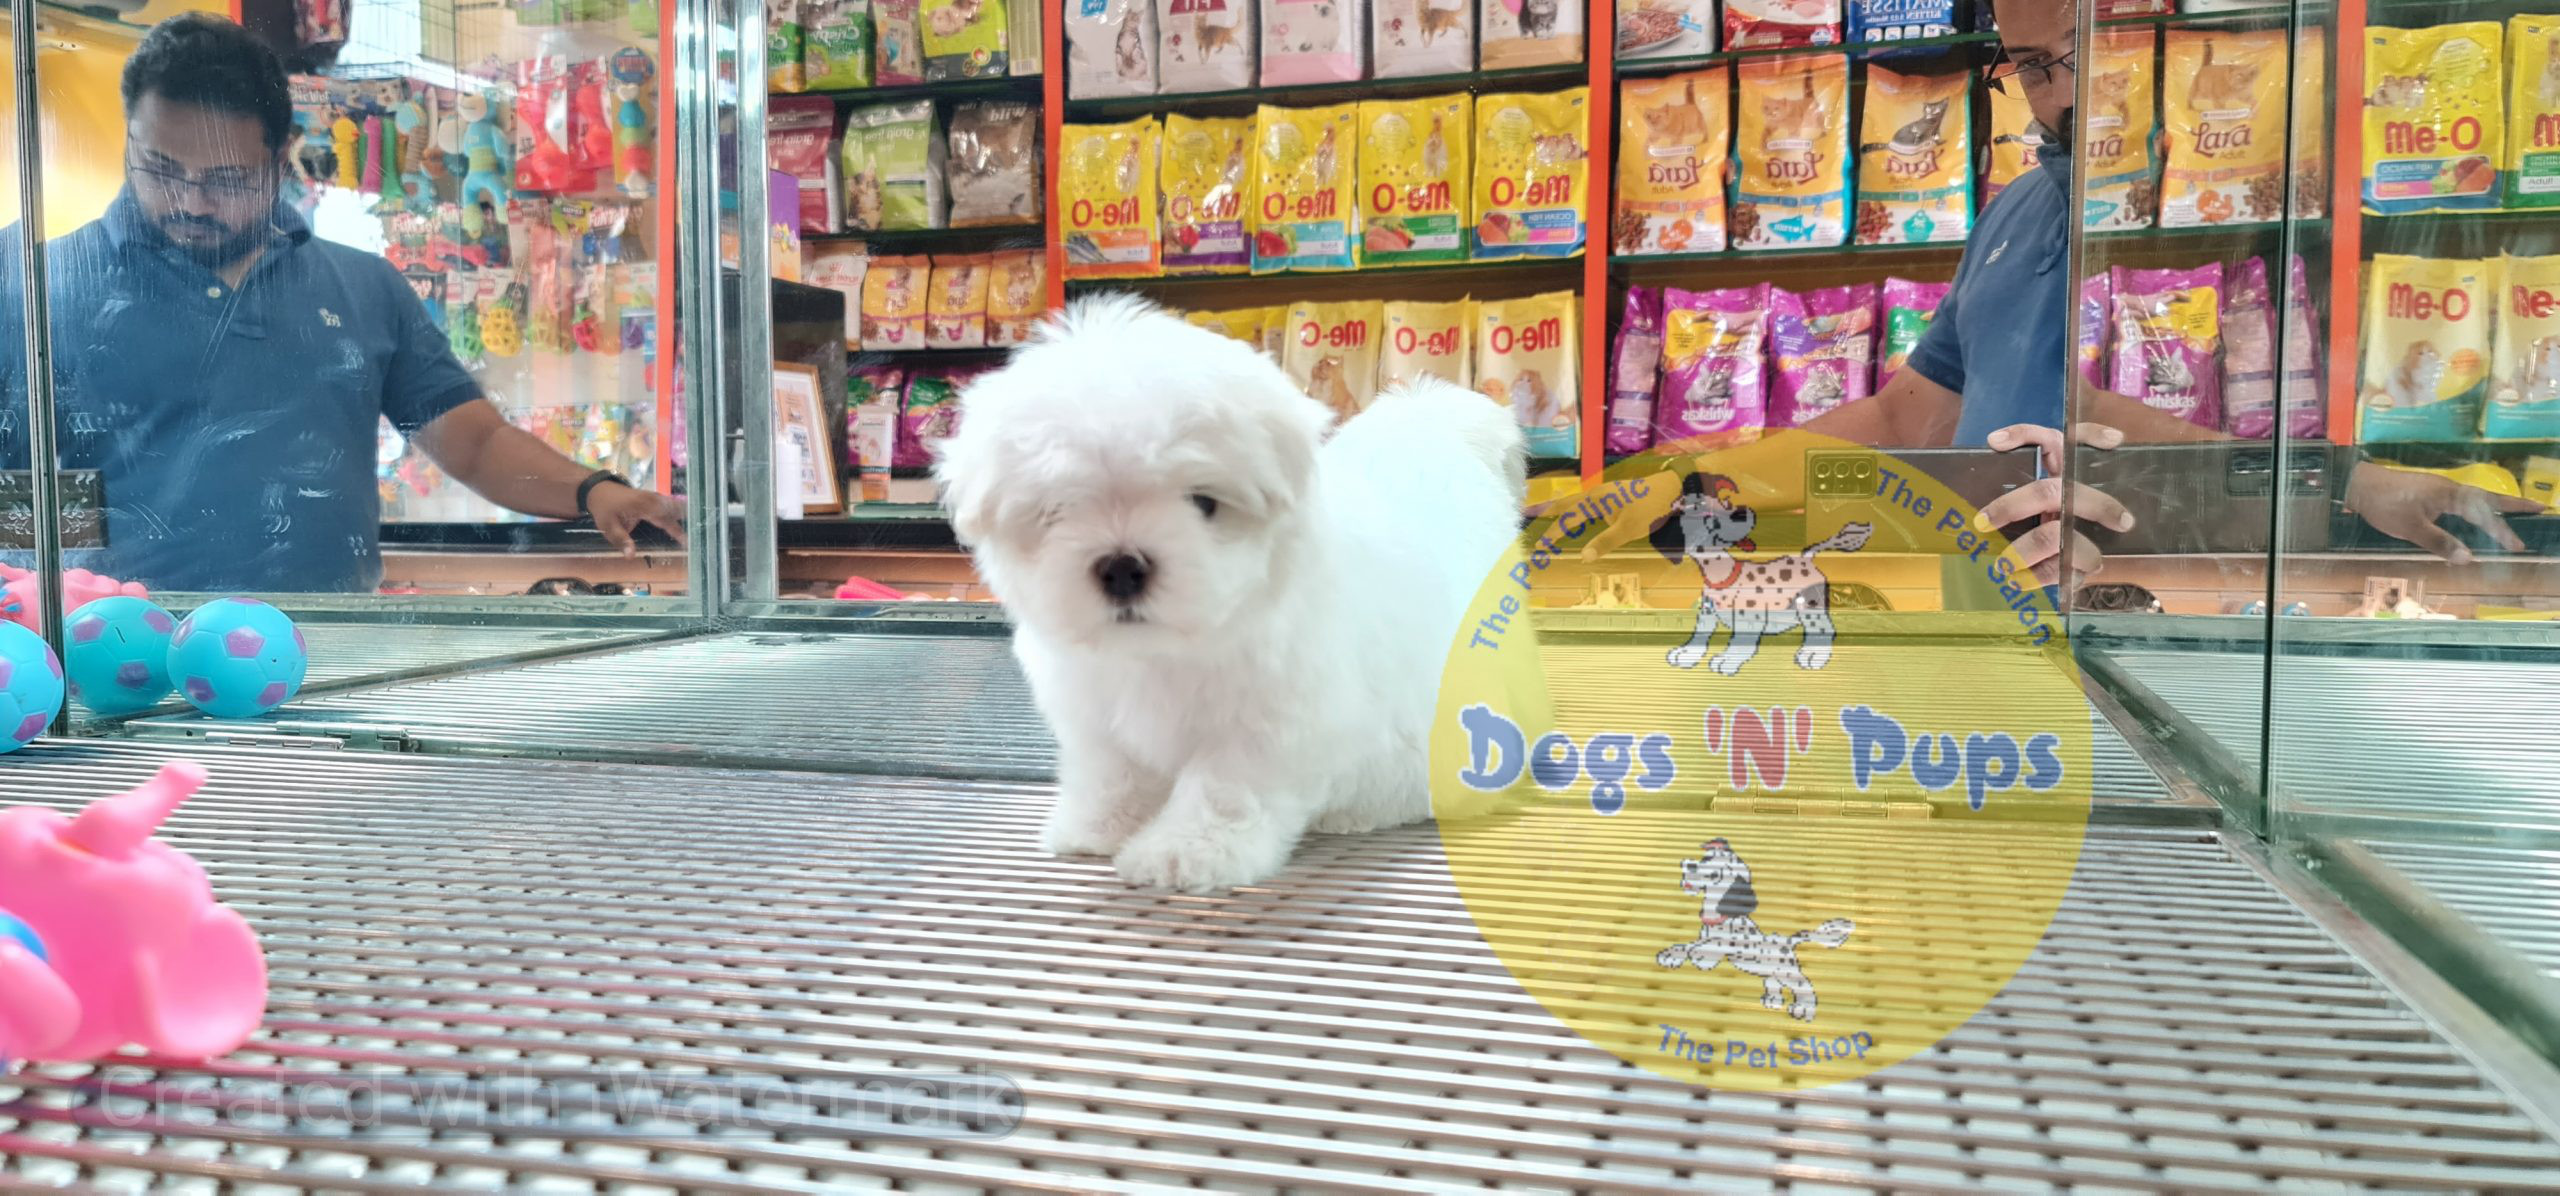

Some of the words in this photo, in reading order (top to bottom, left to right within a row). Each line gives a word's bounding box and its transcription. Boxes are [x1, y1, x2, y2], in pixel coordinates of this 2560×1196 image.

[2191, 122, 2252, 158] Lara
[2385, 116, 2482, 154] Me-O
[2388, 282, 2470, 321] Me-O
